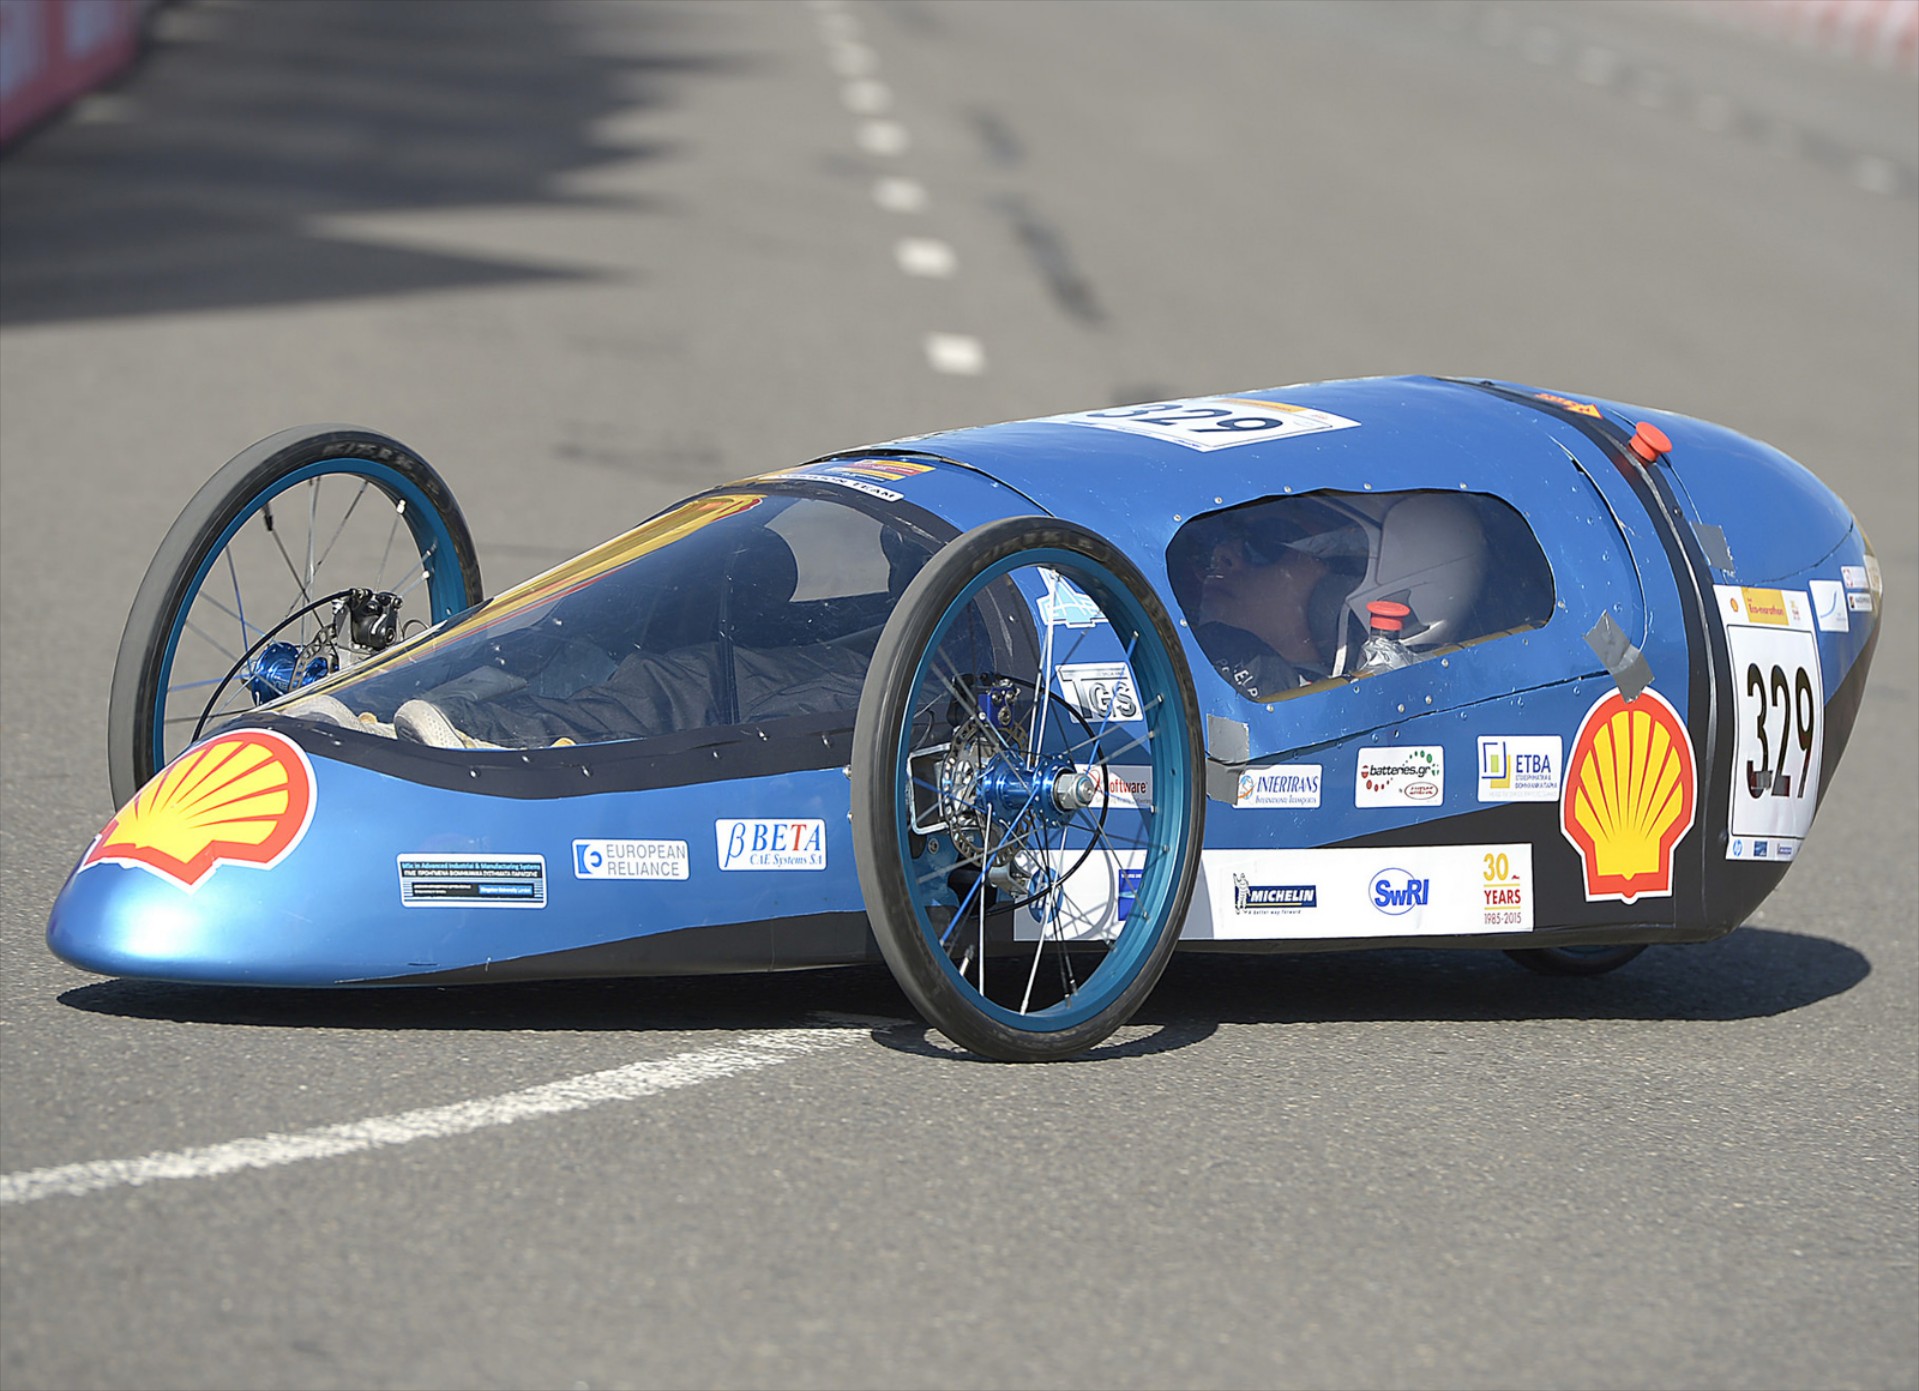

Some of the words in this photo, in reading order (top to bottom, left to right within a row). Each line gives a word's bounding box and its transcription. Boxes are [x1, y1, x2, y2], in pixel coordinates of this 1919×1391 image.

[1087, 404, 1283, 432] 329
[1746, 662, 1814, 799] 329
[1369, 764, 1431, 778] batteries.gr
[1516, 754, 1552, 774] ETBA
[1103, 781, 1147, 795] oftware
[1257, 775, 1319, 793] INTERTRANS
[751, 823, 821, 851] BETA
[606, 844, 686, 859] EUROPEAN
[772, 853, 807, 867] Systems
[1483, 853, 1509, 881] 30
[608, 862, 680, 876] RELIANCE
[1250, 889, 1315, 903] MICHELIN
[1374, 879, 1429, 907] SwRI
[1484, 889, 1521, 905] YEARS
[1484, 912, 1521, 925] 1985-2015
